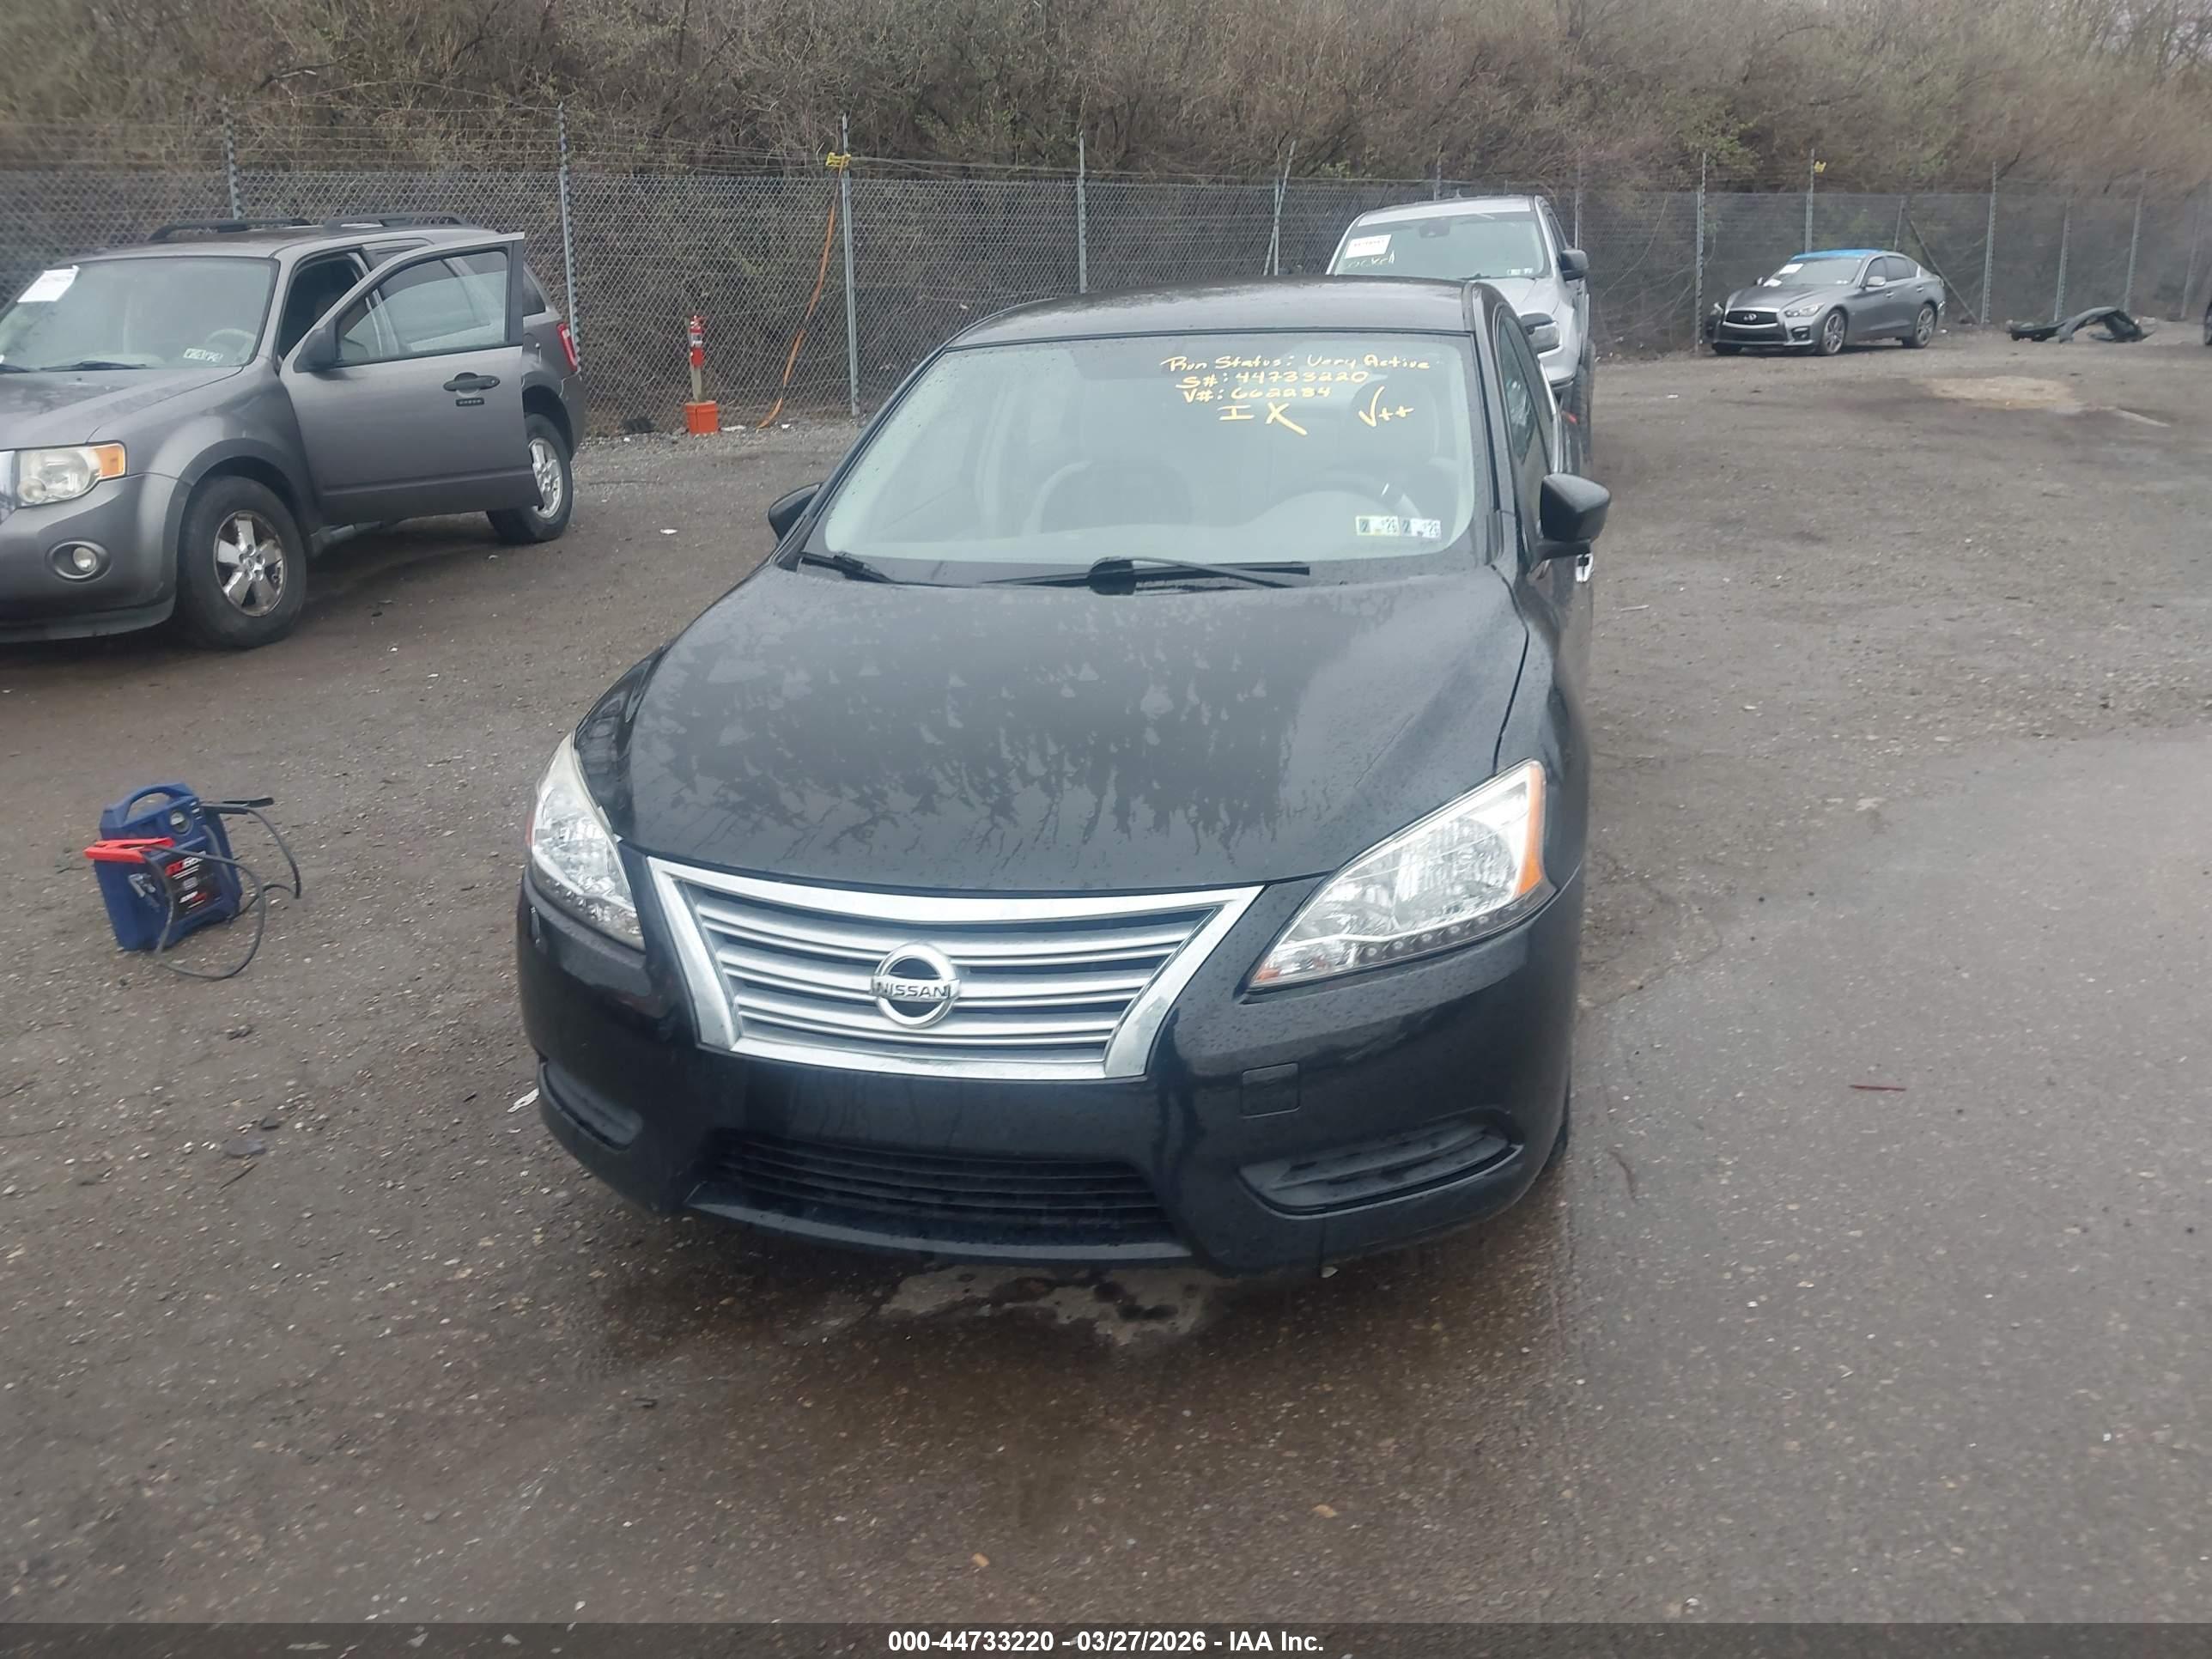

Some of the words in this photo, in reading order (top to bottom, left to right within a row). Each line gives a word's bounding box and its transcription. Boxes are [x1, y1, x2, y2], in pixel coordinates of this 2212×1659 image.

[1364, 353, 1431, 370] Active
[1236, 371, 1369, 384] 44733220
[873, 981, 951, 999] NISSAN
